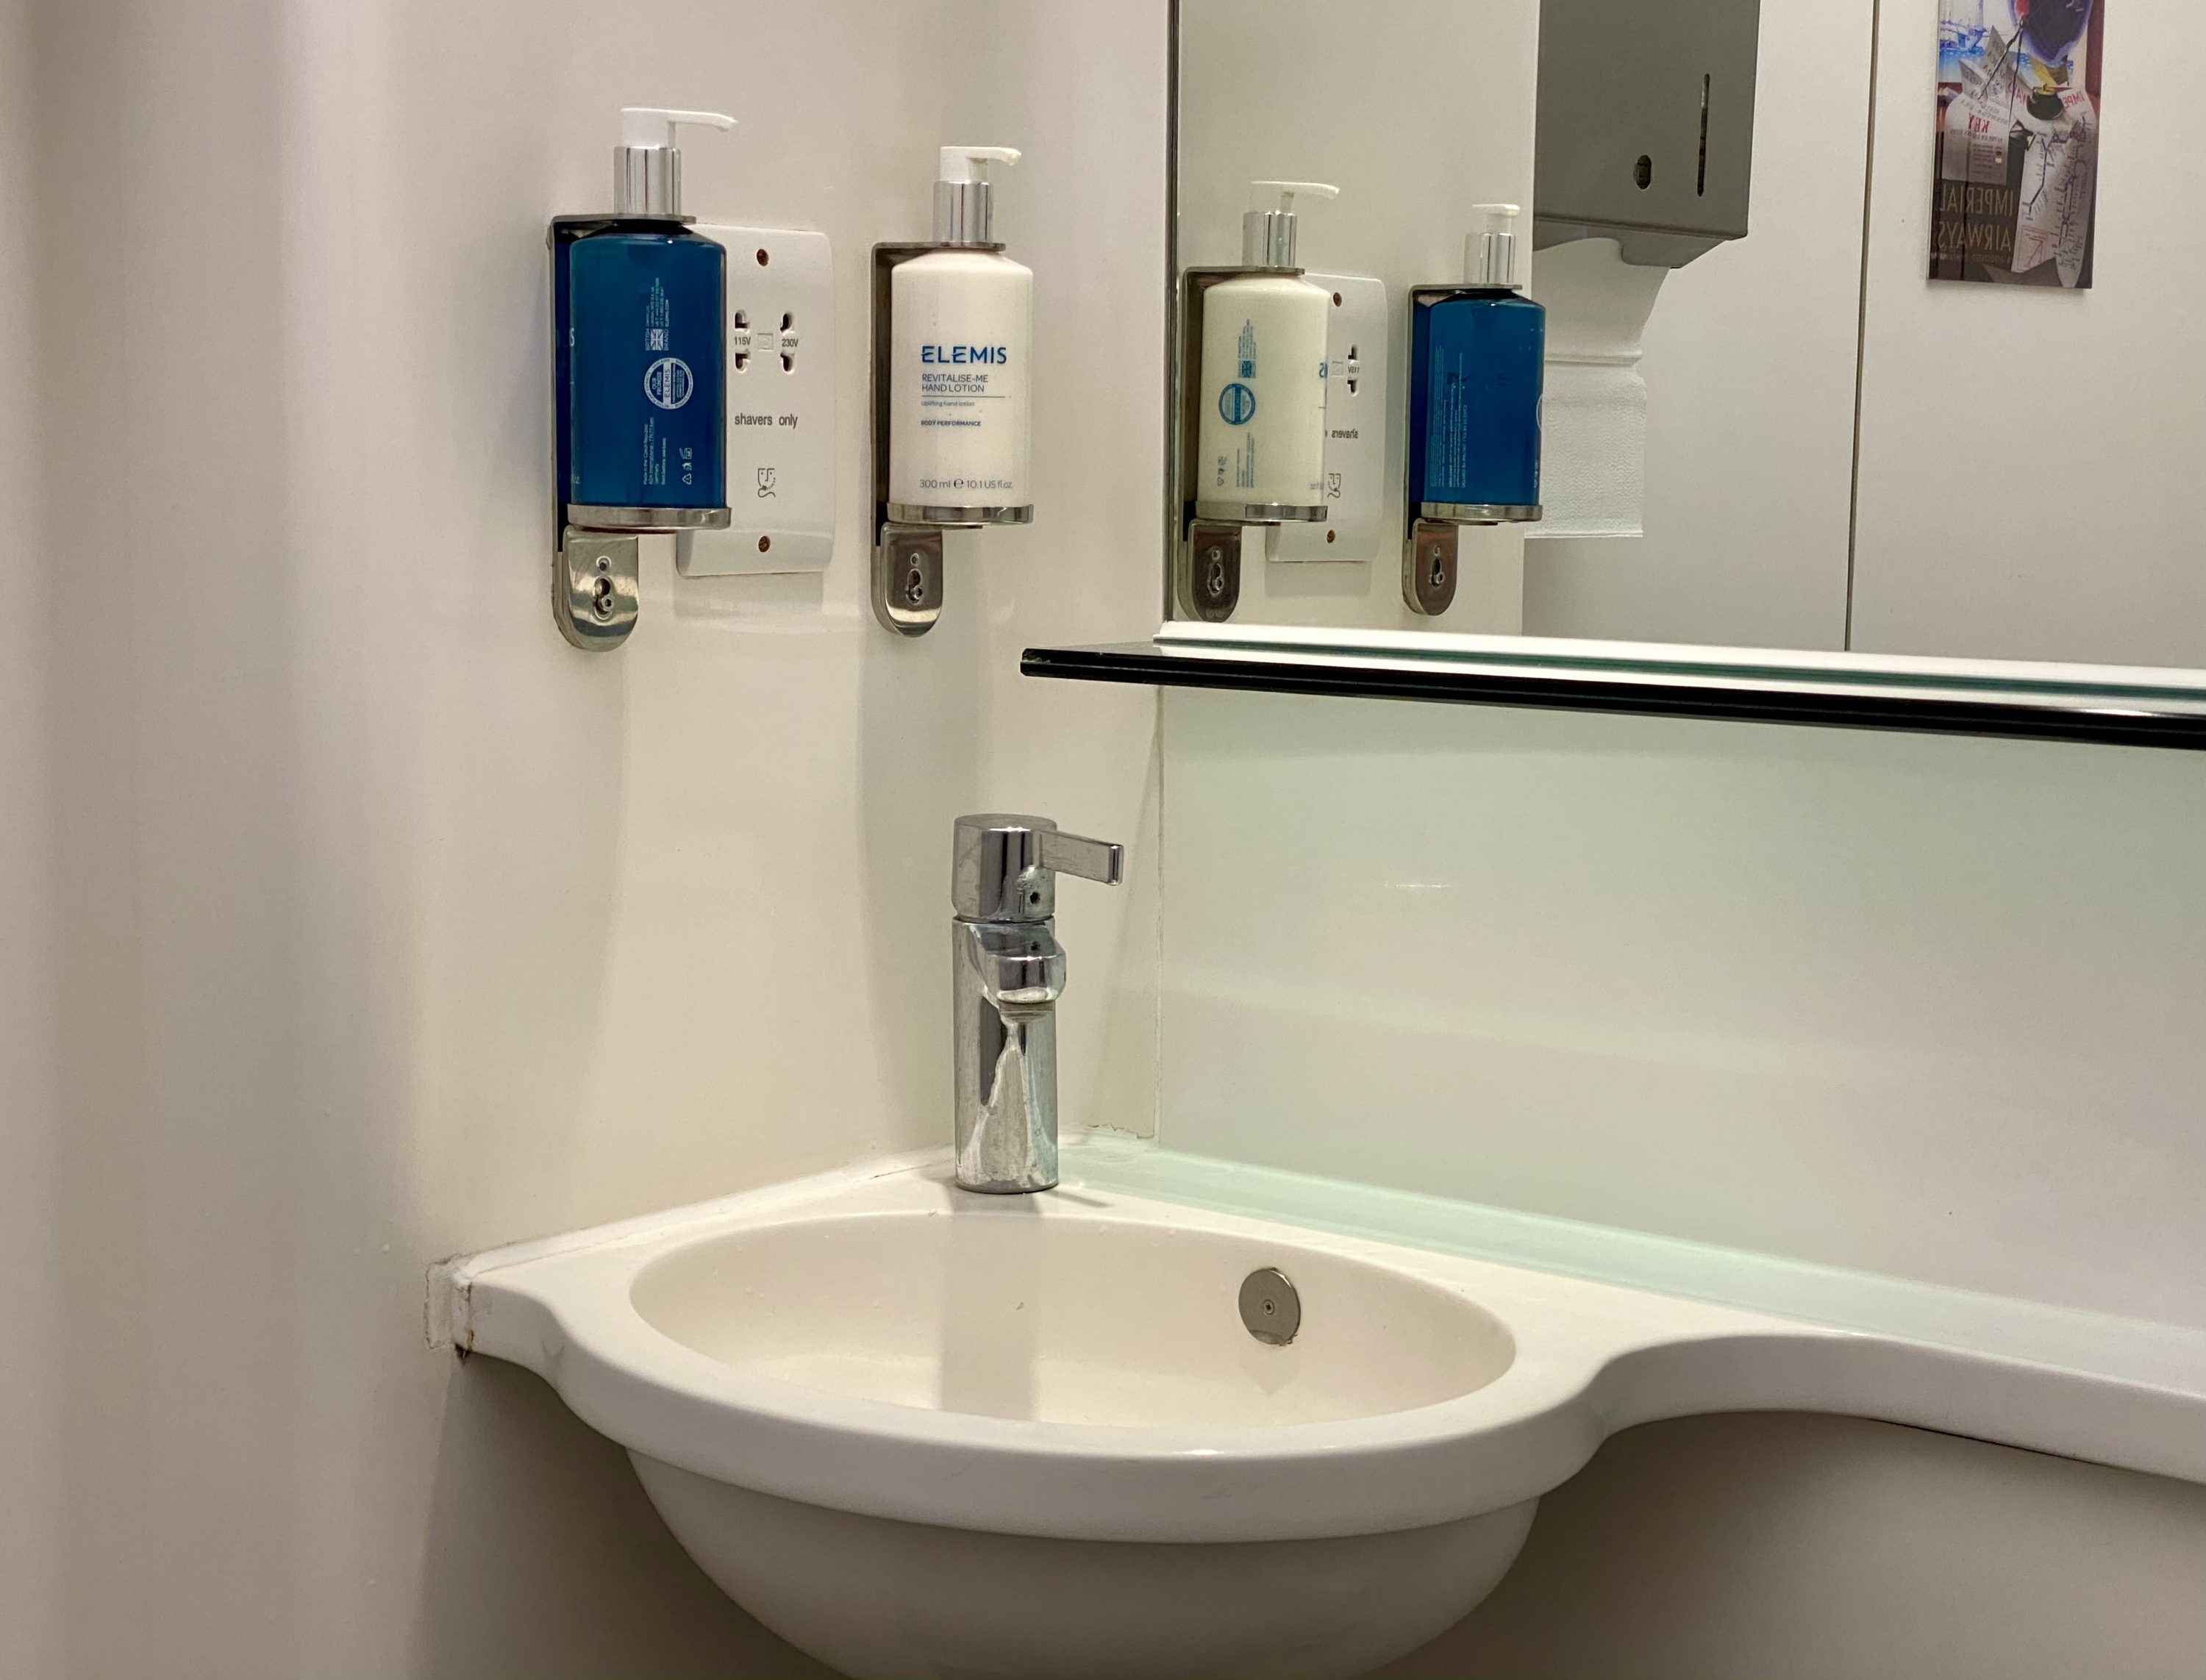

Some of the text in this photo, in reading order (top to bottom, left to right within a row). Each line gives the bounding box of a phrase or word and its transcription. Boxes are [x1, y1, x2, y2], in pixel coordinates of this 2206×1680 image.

[735, 336, 799, 348] 115V 230V
[921, 346, 1007, 364] ELEMIS
[922, 373, 988, 383] REVITALISE-ME
[922, 384, 985, 393] HAND LOTION
[735, 413, 799, 429] shavers only
[919, 479, 938, 488] 300
[939, 479, 951, 488] ml
[967, 480, 982, 489] 10.1
[985, 480, 996, 489] US
